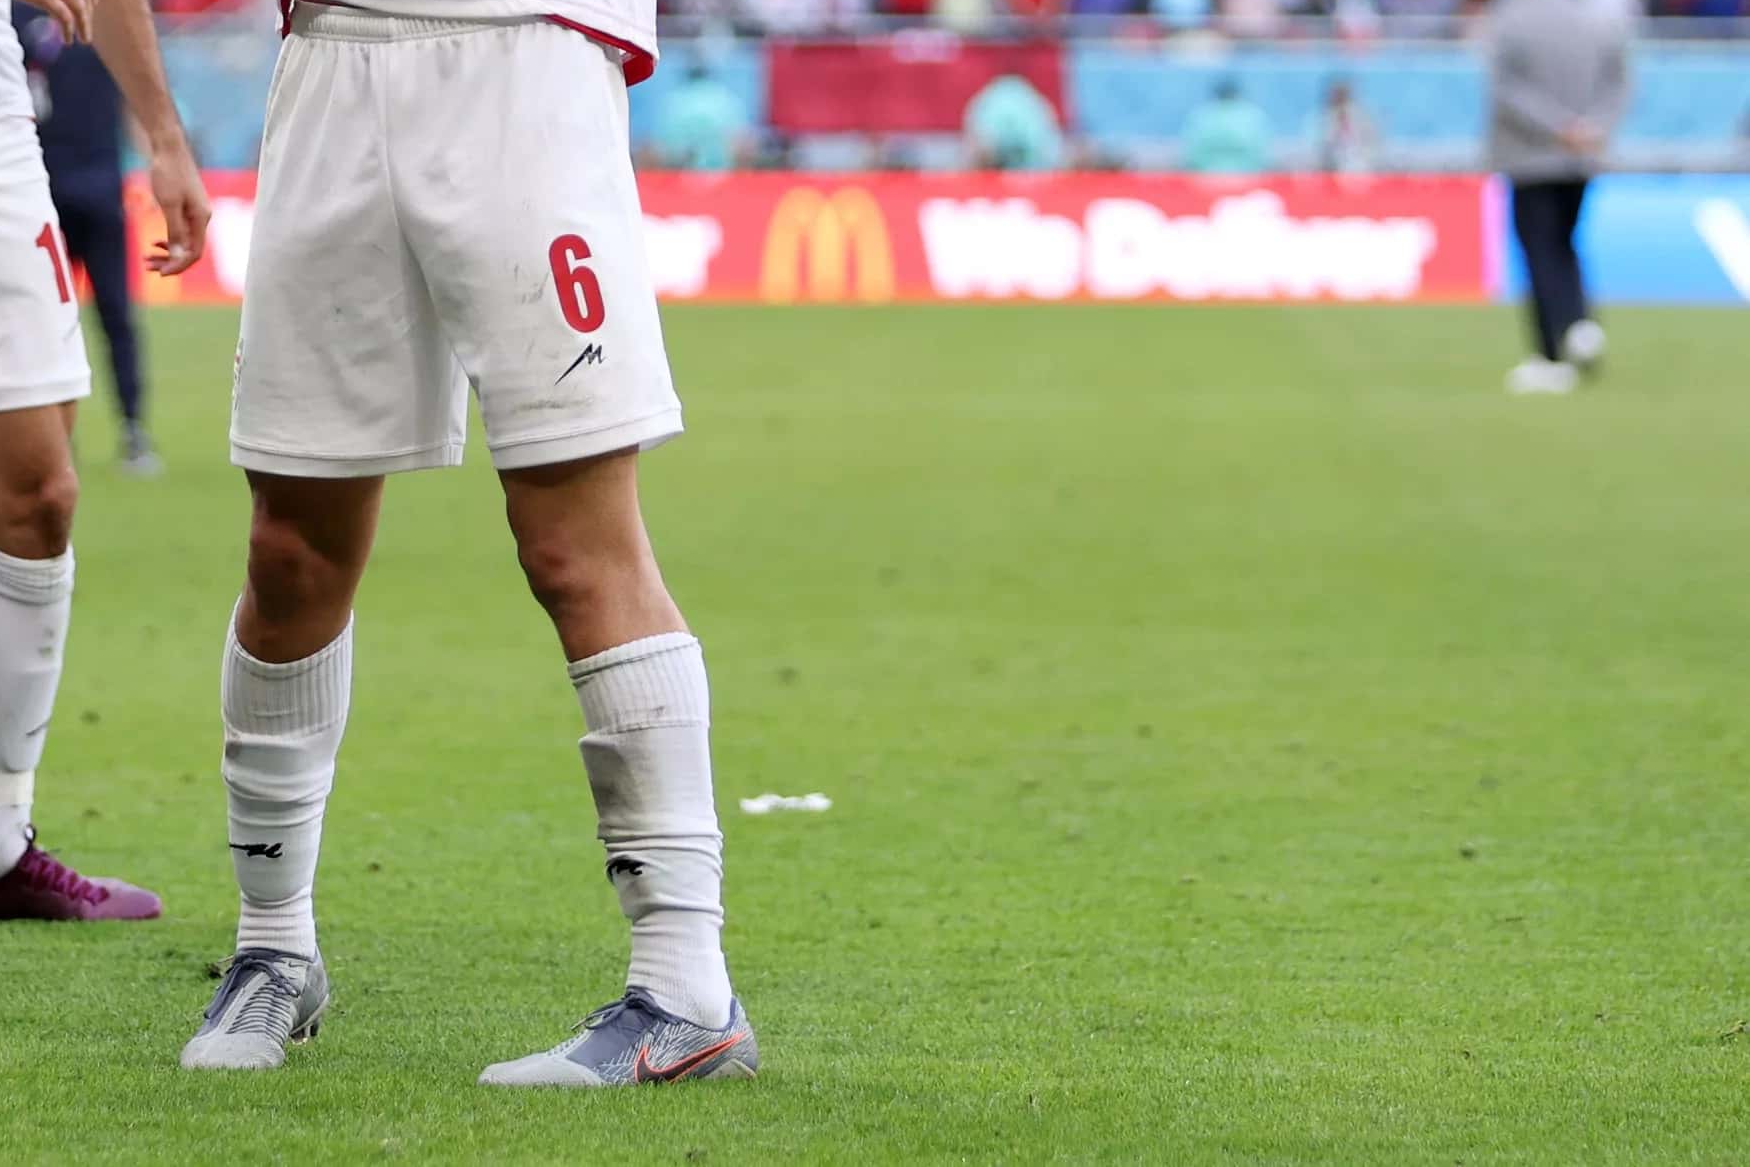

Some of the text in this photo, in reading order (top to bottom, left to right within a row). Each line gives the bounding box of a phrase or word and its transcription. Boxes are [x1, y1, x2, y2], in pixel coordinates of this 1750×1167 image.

[549, 234, 605, 333] 6
[918, 190, 1436, 300] We Deliver
